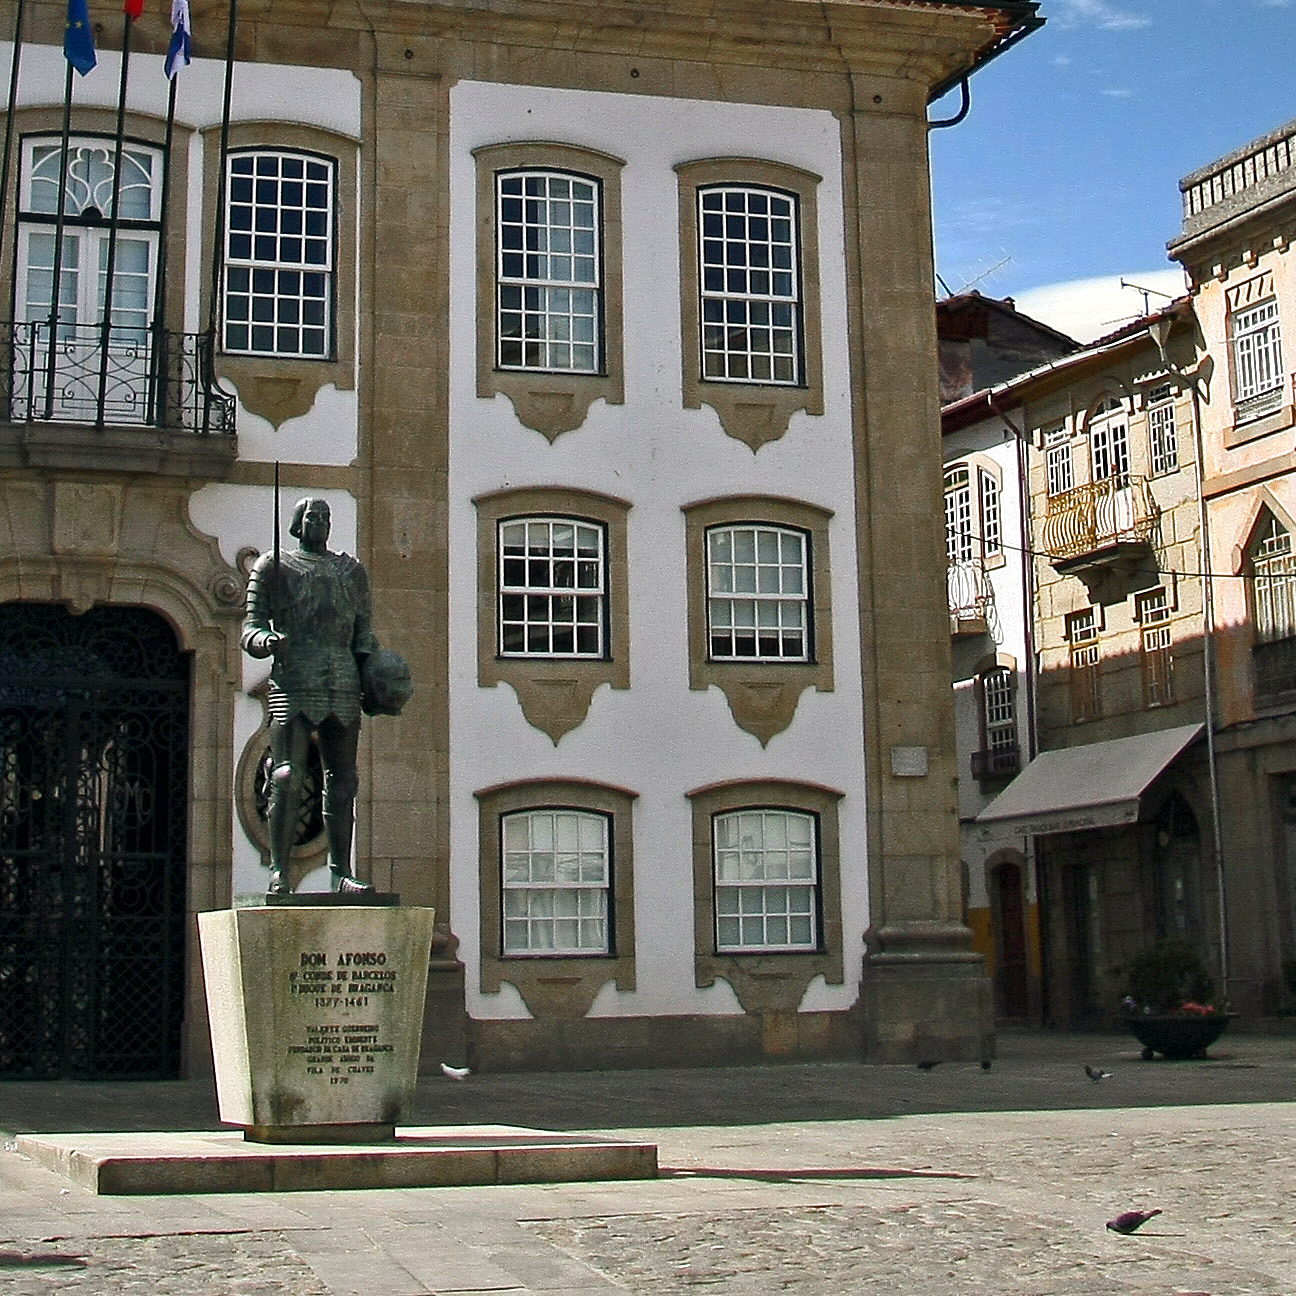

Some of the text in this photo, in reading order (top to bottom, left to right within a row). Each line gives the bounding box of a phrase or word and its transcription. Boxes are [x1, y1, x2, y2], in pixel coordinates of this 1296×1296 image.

[301, 952, 387, 966] DOM AFONSO
[337, 970, 347, 980] DE
[331, 984, 342, 994] DE
